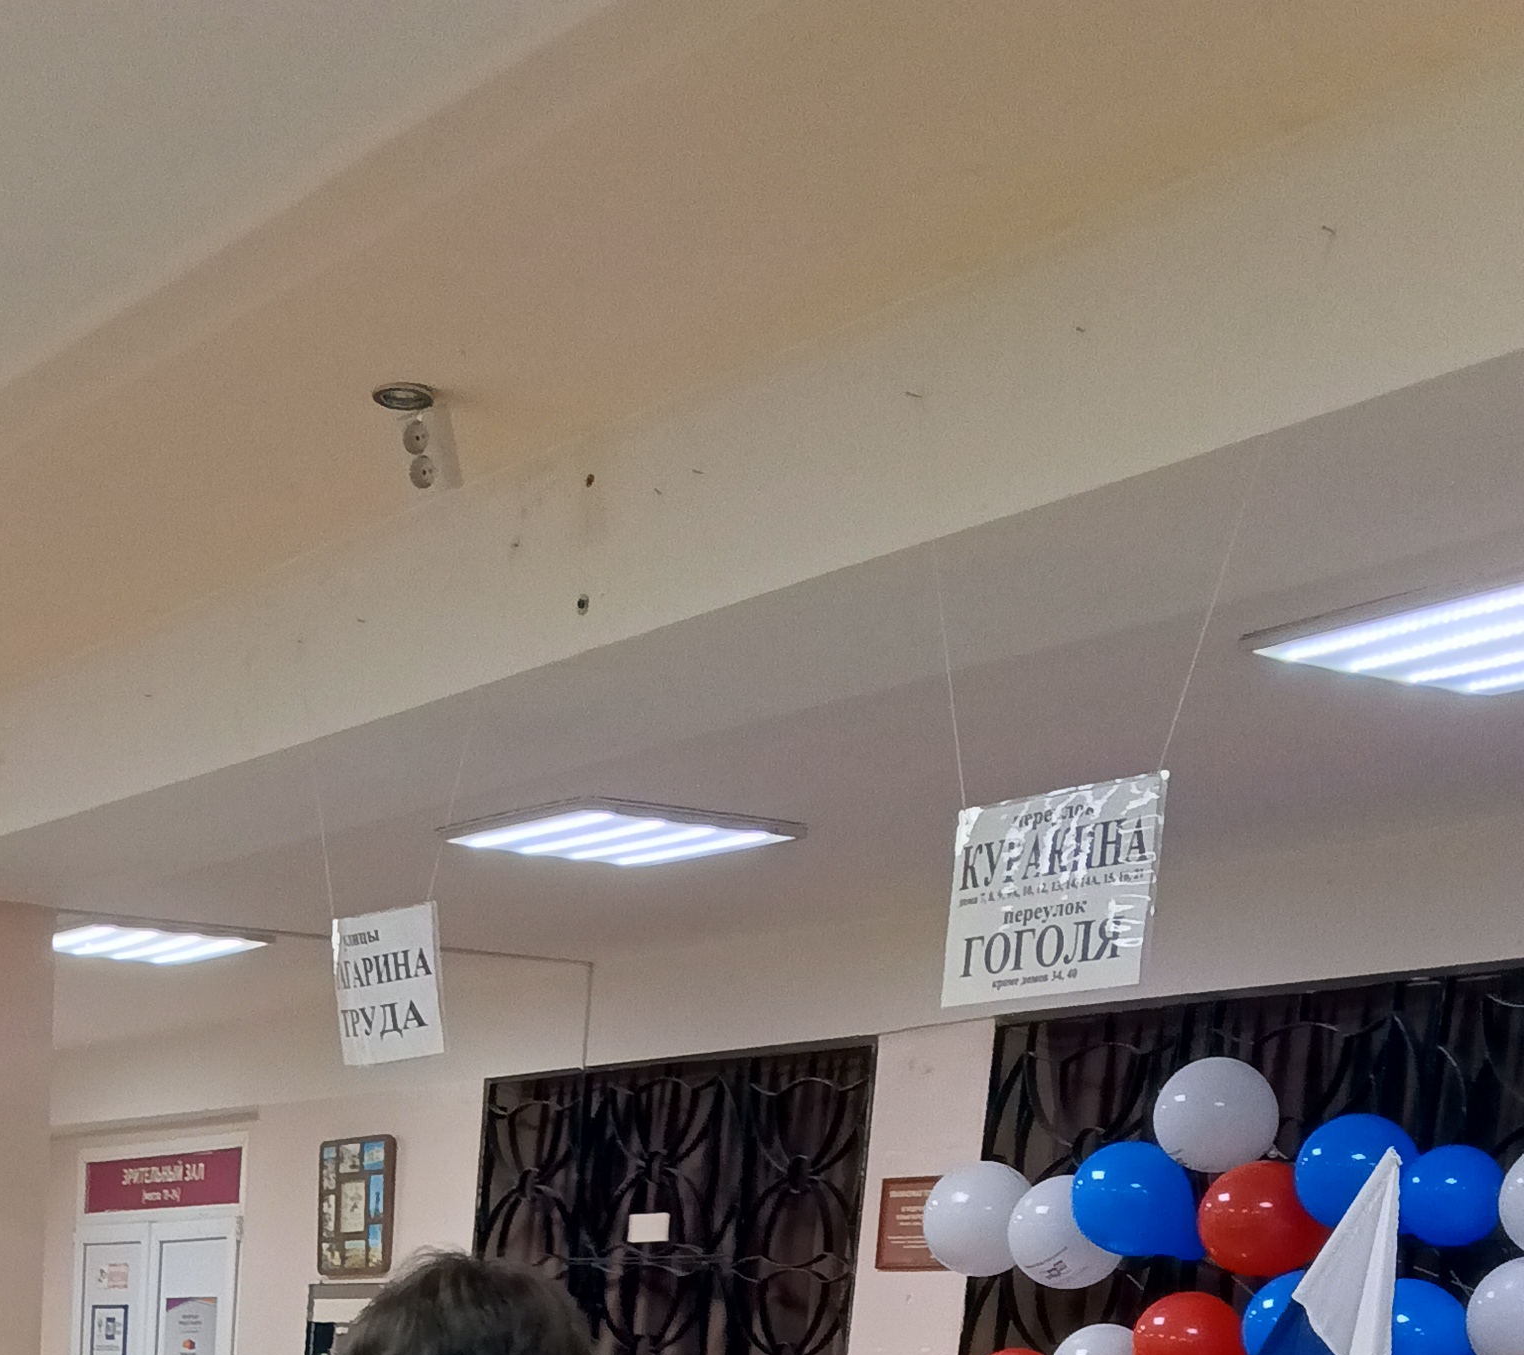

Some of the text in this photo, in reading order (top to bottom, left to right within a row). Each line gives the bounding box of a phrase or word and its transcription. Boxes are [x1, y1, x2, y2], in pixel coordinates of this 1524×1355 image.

[1002, 900, 1088, 926] переулок
[959, 915, 1126, 978] ГОГОЛЯ
[340, 1000, 429, 1040] ТРУДА
